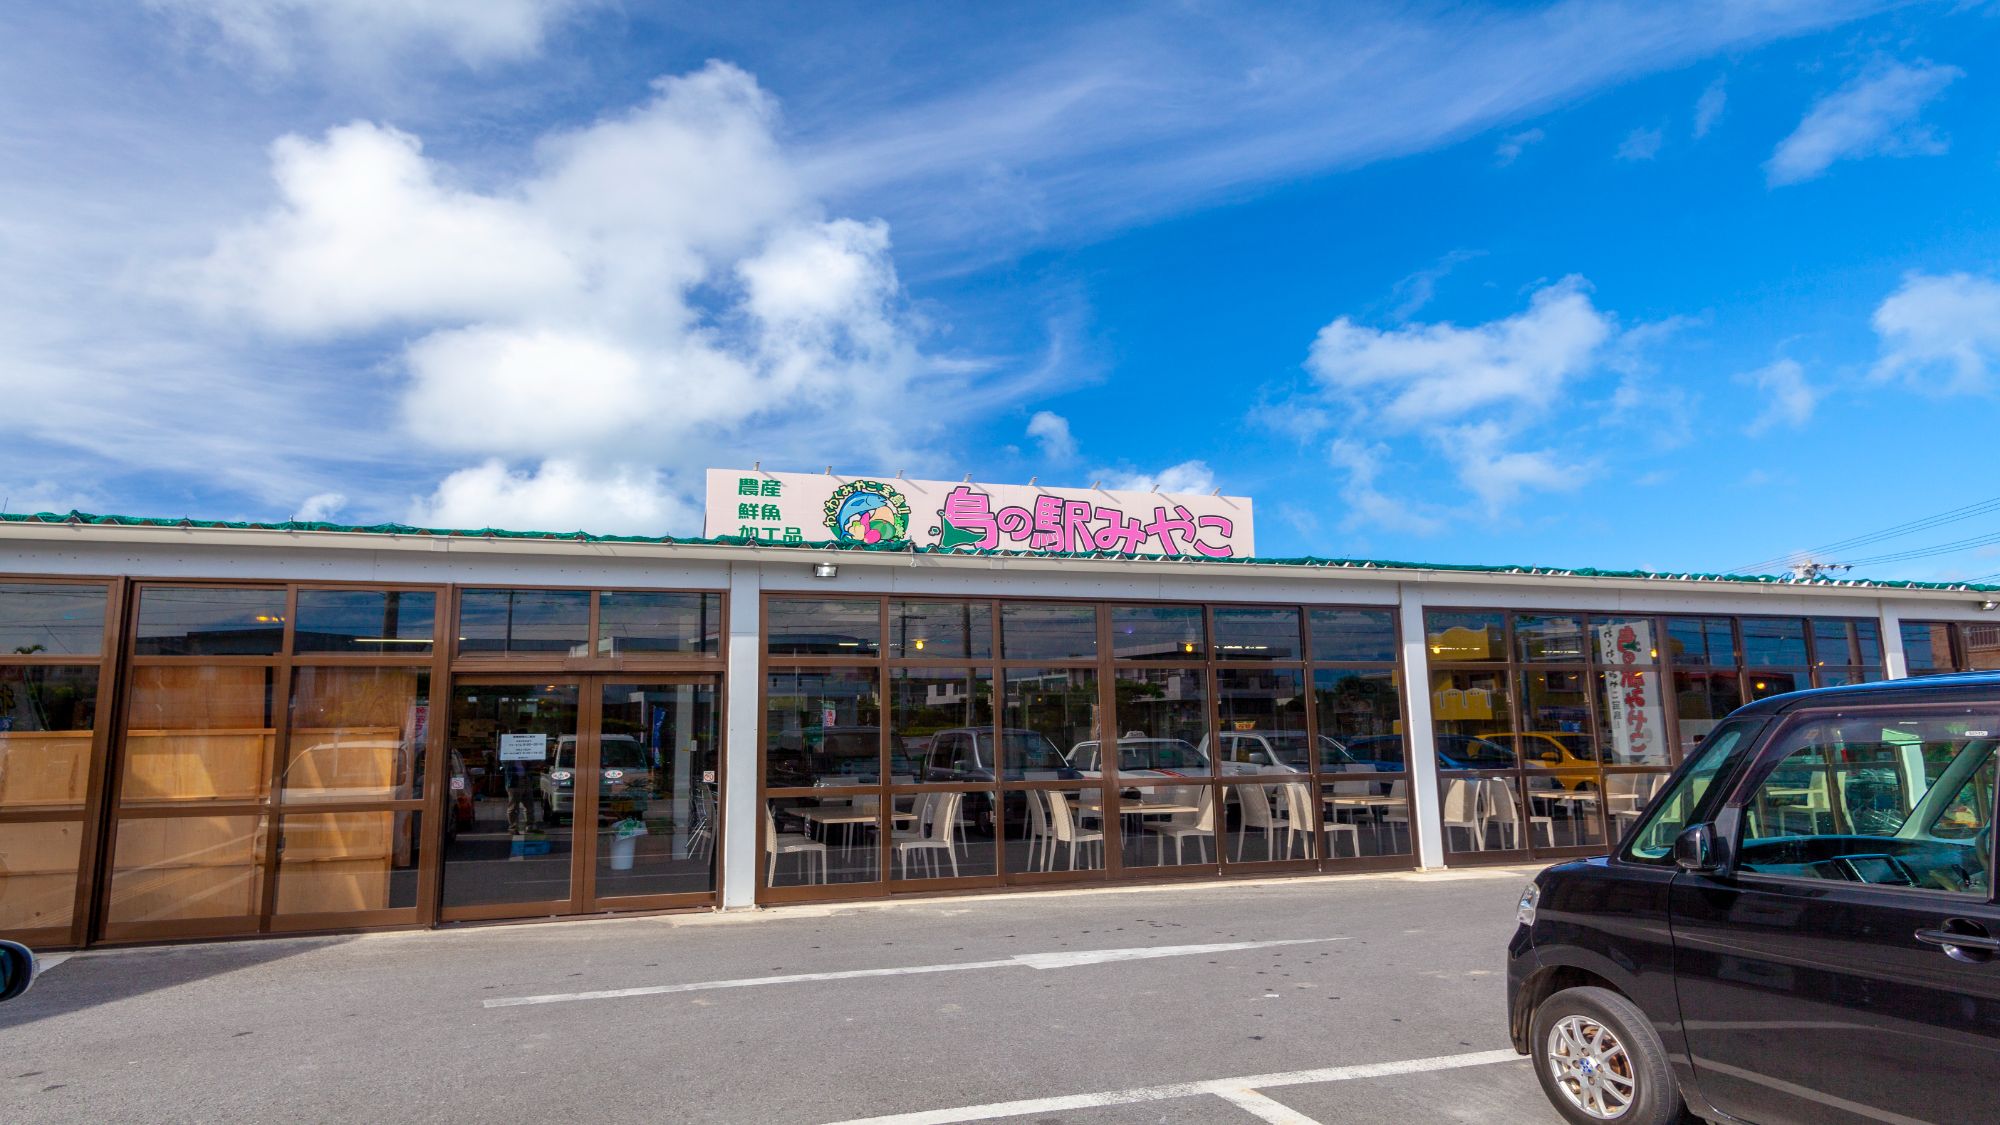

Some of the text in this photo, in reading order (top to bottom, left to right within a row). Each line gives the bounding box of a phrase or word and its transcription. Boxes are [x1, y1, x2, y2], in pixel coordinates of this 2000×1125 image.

[738, 478, 781, 497] 農産
[738, 503, 781, 521] 鮮魚
[944, 486, 1234, 557] 島の駅みやこ
[738, 525, 803, 543] 加工品
